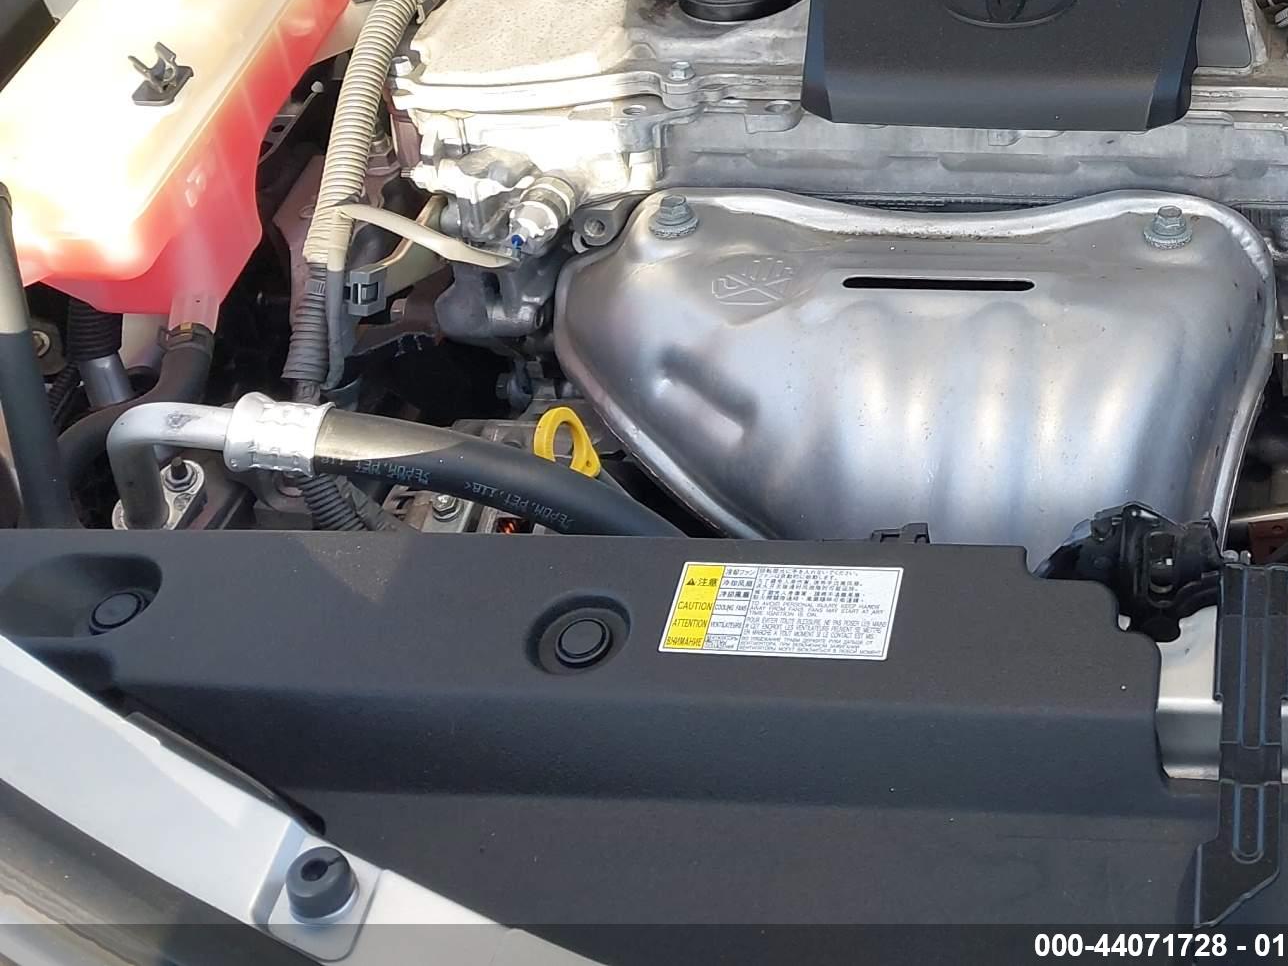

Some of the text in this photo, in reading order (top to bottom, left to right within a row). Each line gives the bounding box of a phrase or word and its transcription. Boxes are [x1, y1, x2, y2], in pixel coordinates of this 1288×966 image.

[698, 578, 718, 587] 注意
[678, 601, 712, 611] CAUTION
[714, 604, 735, 612] COOLING
[673, 619, 707, 628] ATTENTION
[666, 637, 702, 646] ВНИМАНИЕ
